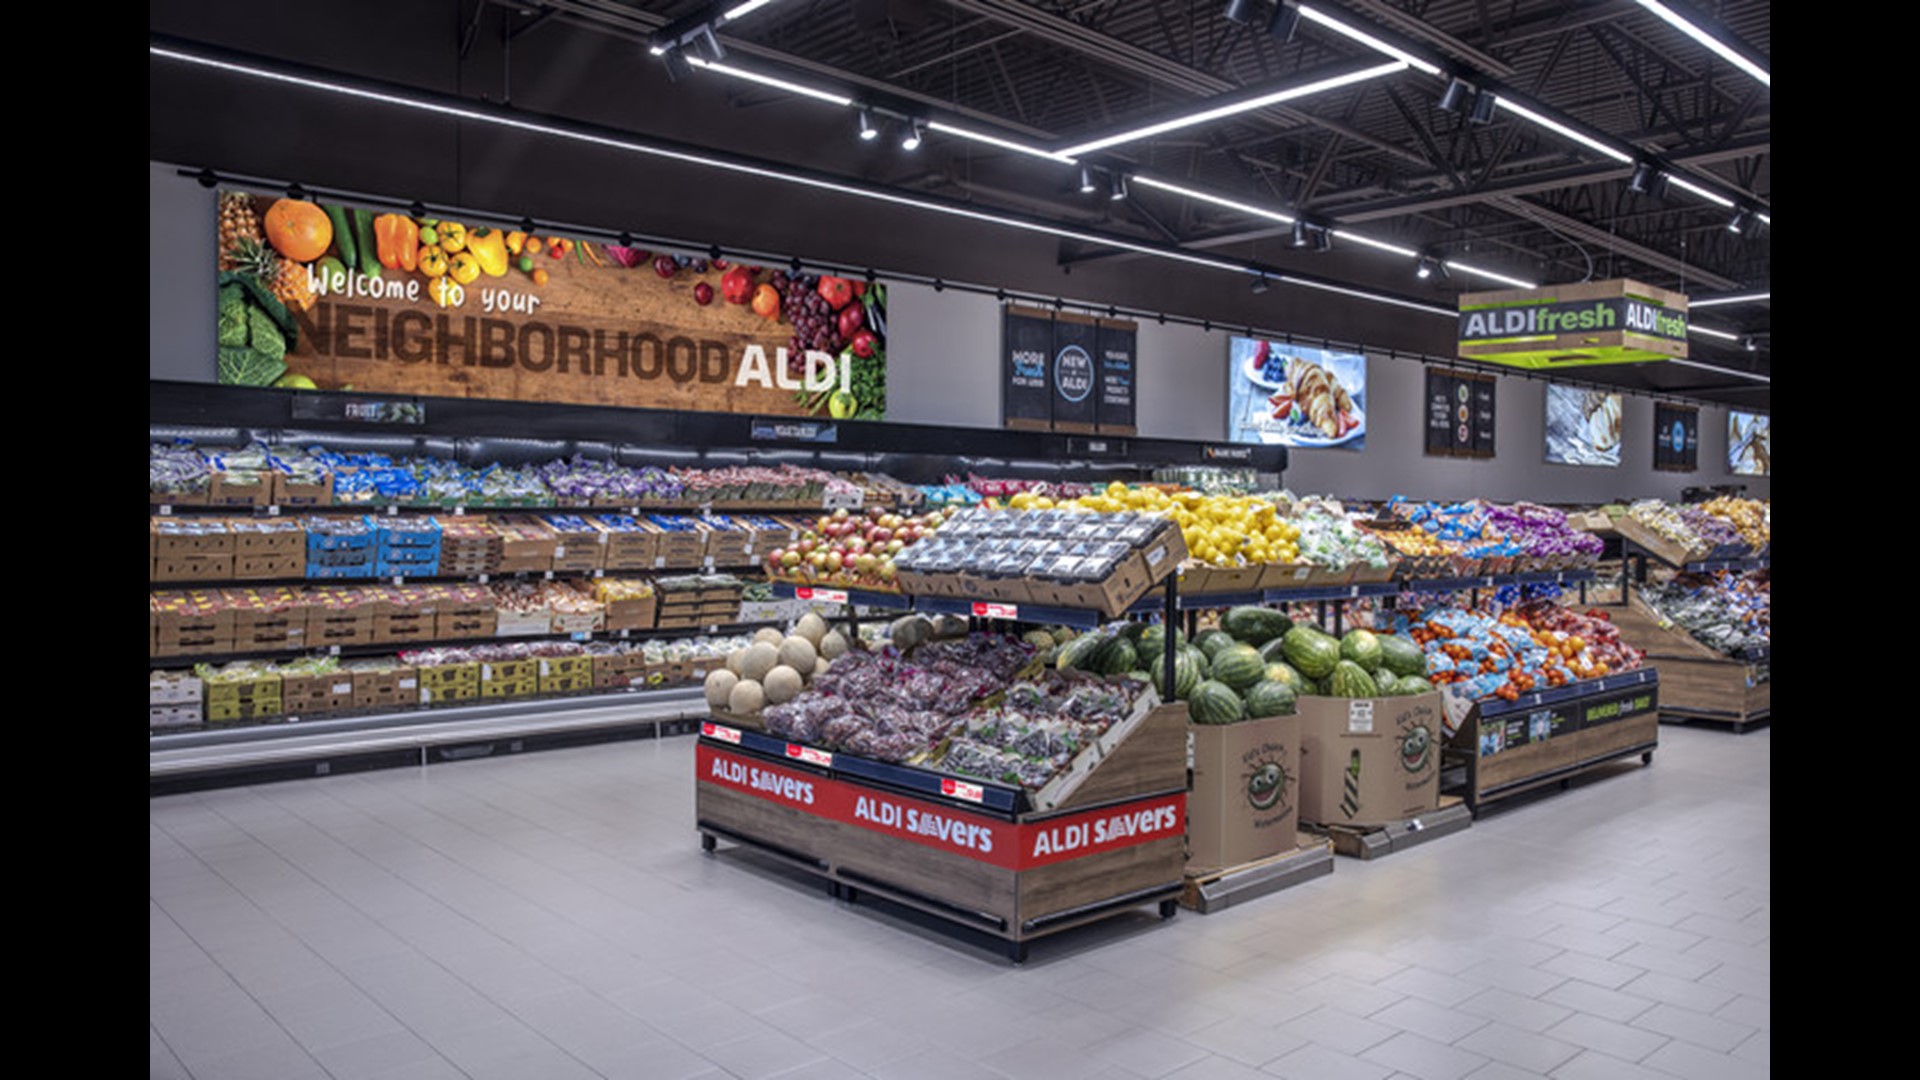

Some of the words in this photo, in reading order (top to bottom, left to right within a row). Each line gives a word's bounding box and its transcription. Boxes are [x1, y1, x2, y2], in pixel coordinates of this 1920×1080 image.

[307, 263, 420, 301] Welcome
[438, 276, 465, 308] to
[481, 286, 541, 314] your
[1465, 303, 1616, 337] ALDIfresh
[297, 301, 730, 384] NEIGHBORHOOD
[735, 344, 851, 394] ALDI
[1062, 354, 1087, 368] NEW
[1062, 376, 1087, 390] ALDI
[712, 758, 748, 786] ALDI
[855, 796, 902, 829] ALDI
[1033, 822, 1090, 857] ALDI
